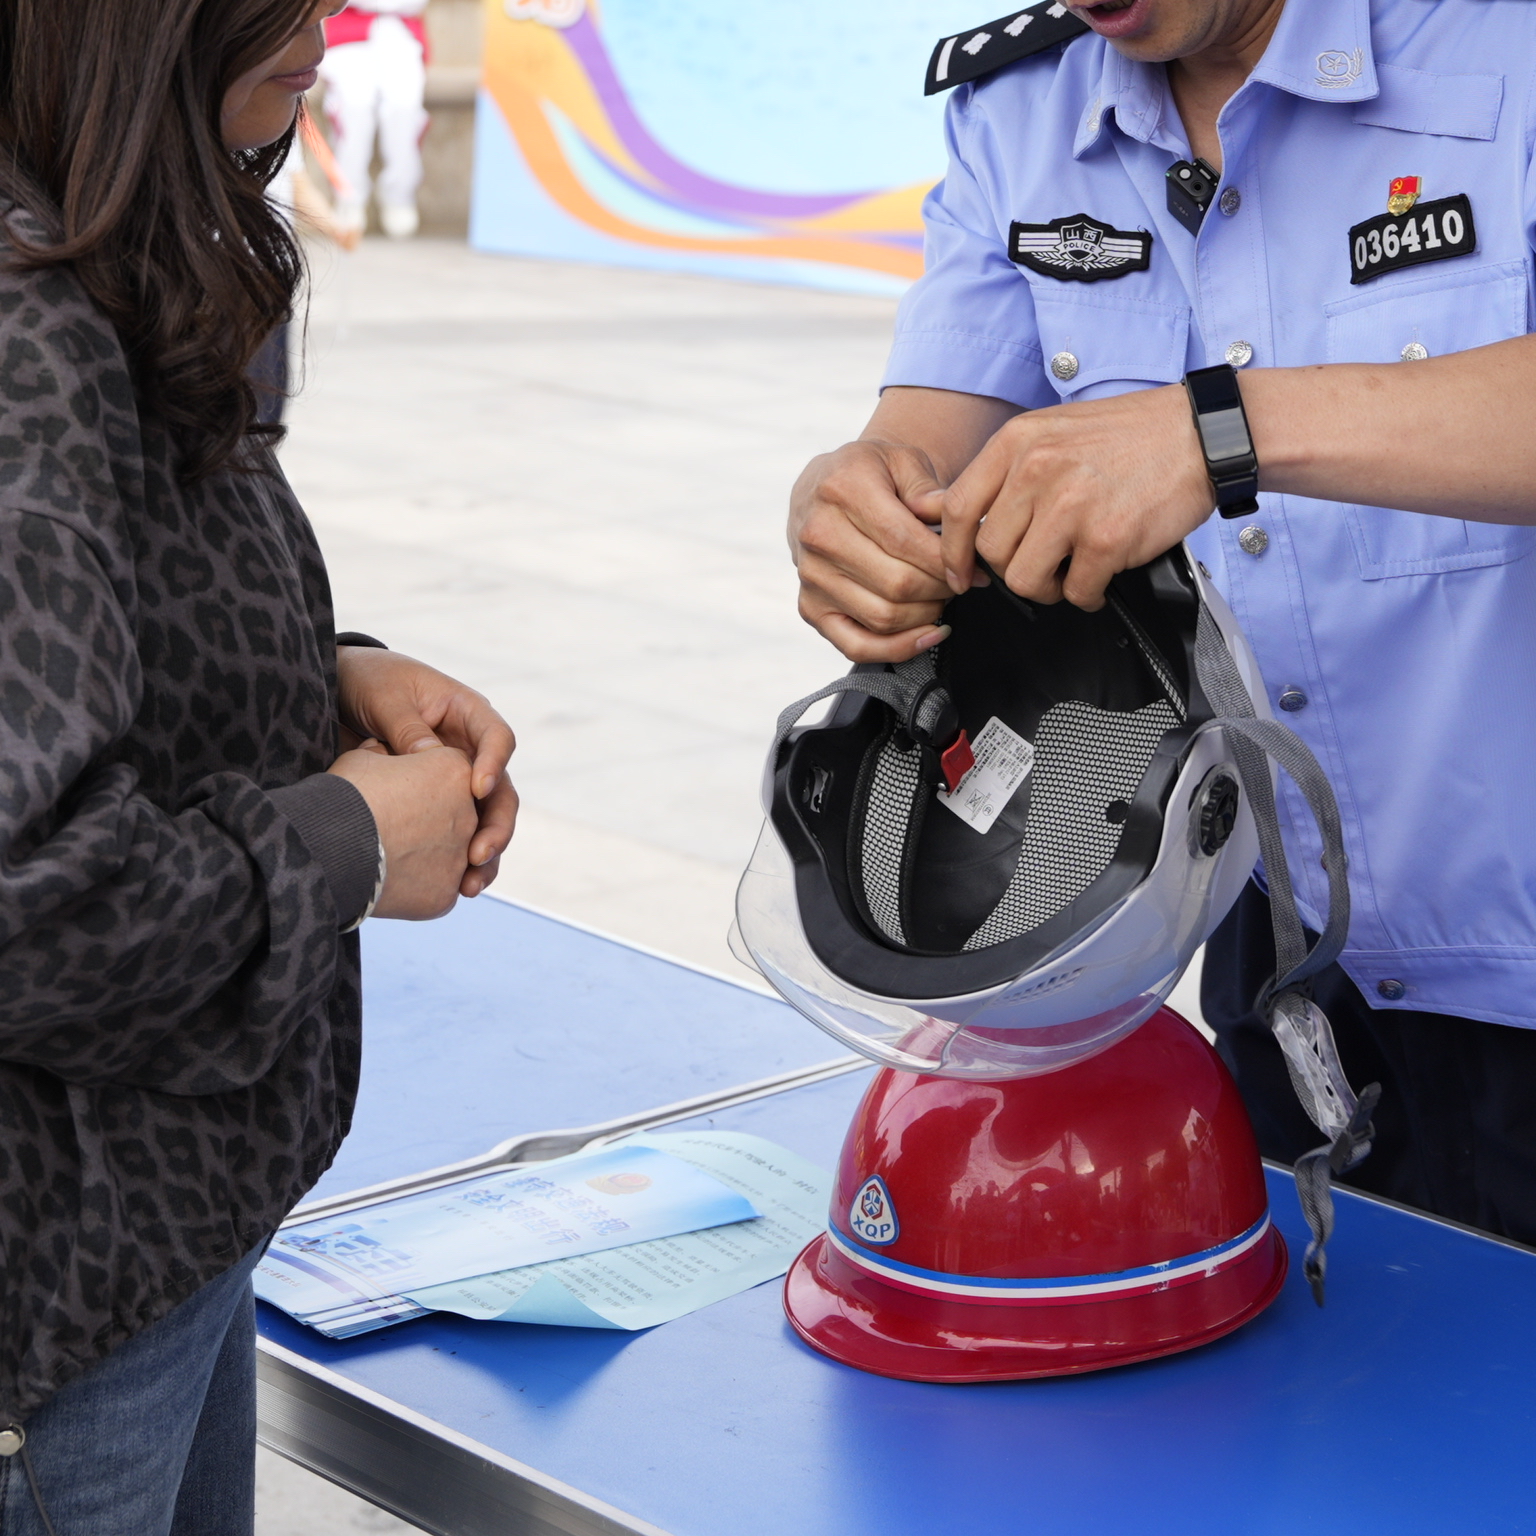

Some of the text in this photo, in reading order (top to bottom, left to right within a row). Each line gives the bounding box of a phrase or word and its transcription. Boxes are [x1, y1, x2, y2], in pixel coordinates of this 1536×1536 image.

[1065, 228, 1099, 242] 山西
[1355, 209, 1464, 270] 036410
[1063, 242, 1097, 253] POLICE
[853, 1214, 891, 1239] XQP
